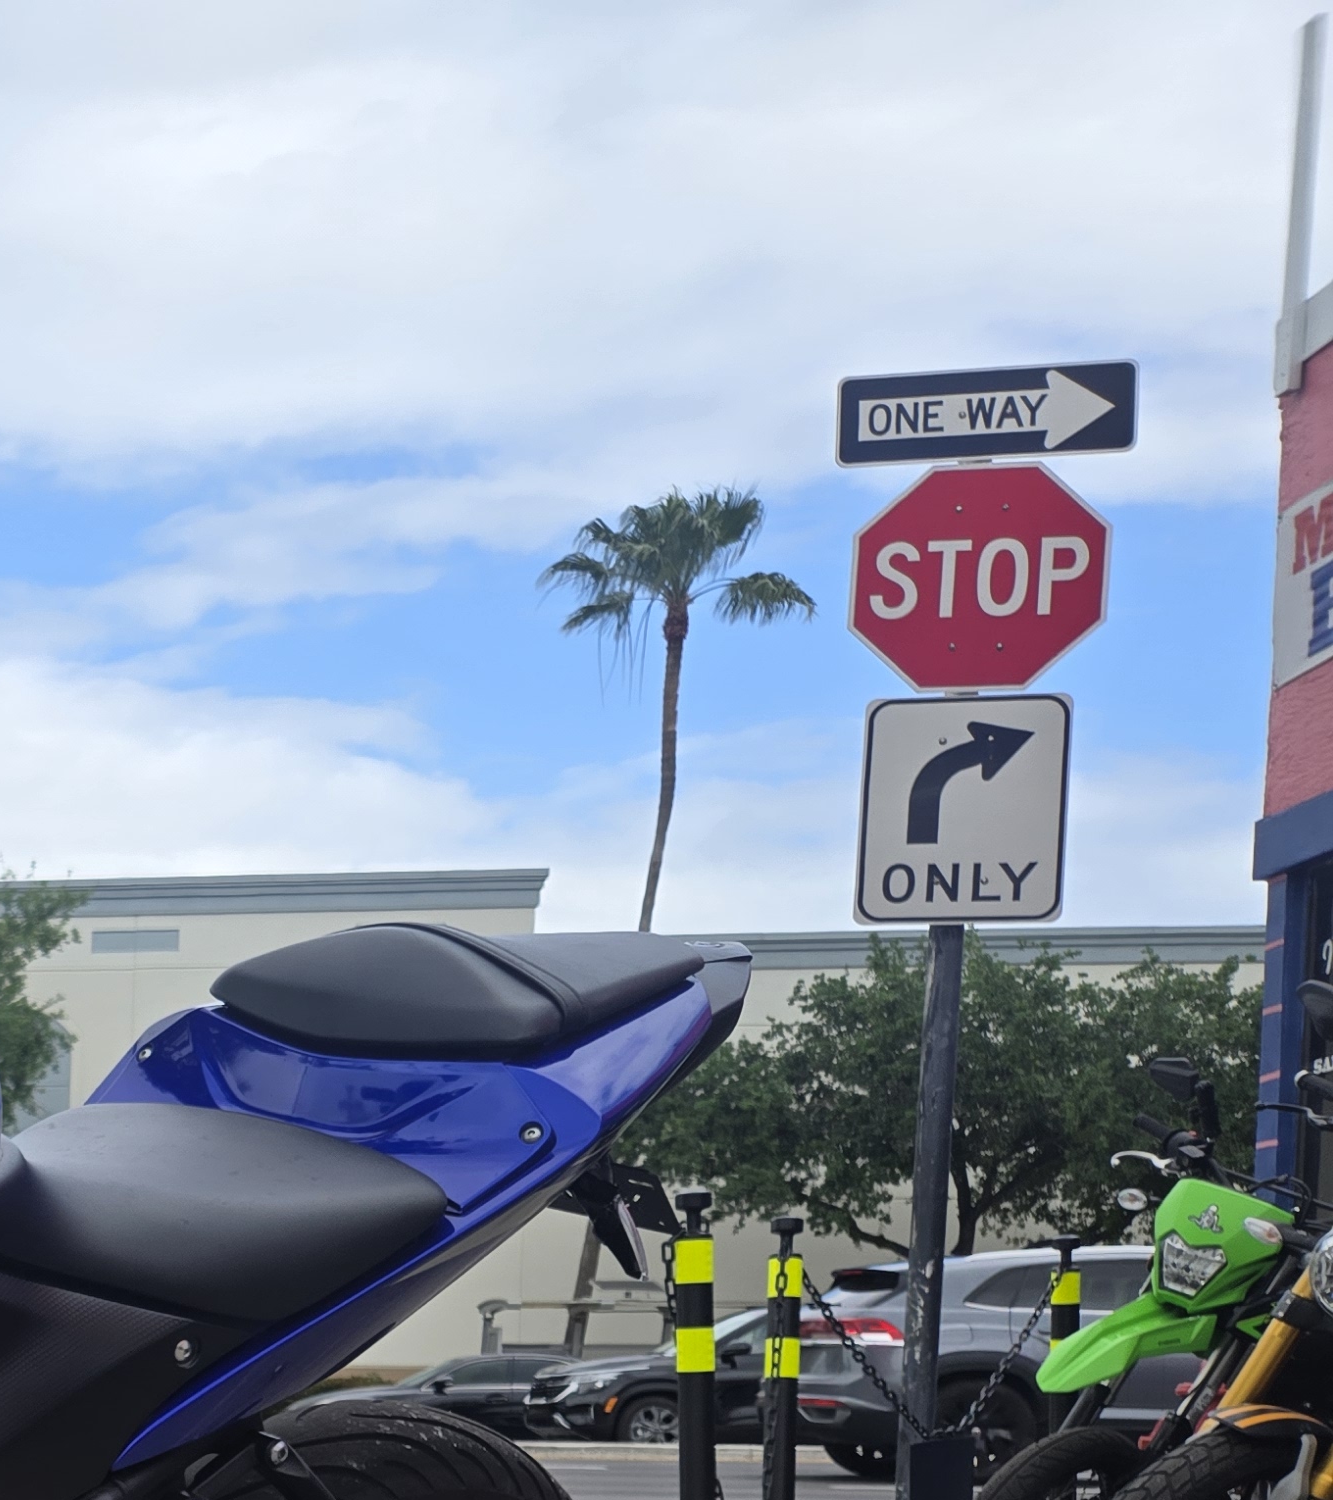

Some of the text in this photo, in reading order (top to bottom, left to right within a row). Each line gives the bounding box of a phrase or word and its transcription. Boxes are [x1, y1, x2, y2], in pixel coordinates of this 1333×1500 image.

[868, 393, 1049, 436] ONE WAY
[869, 536, 1090, 620] STOP
[882, 861, 1039, 904] ONLY
